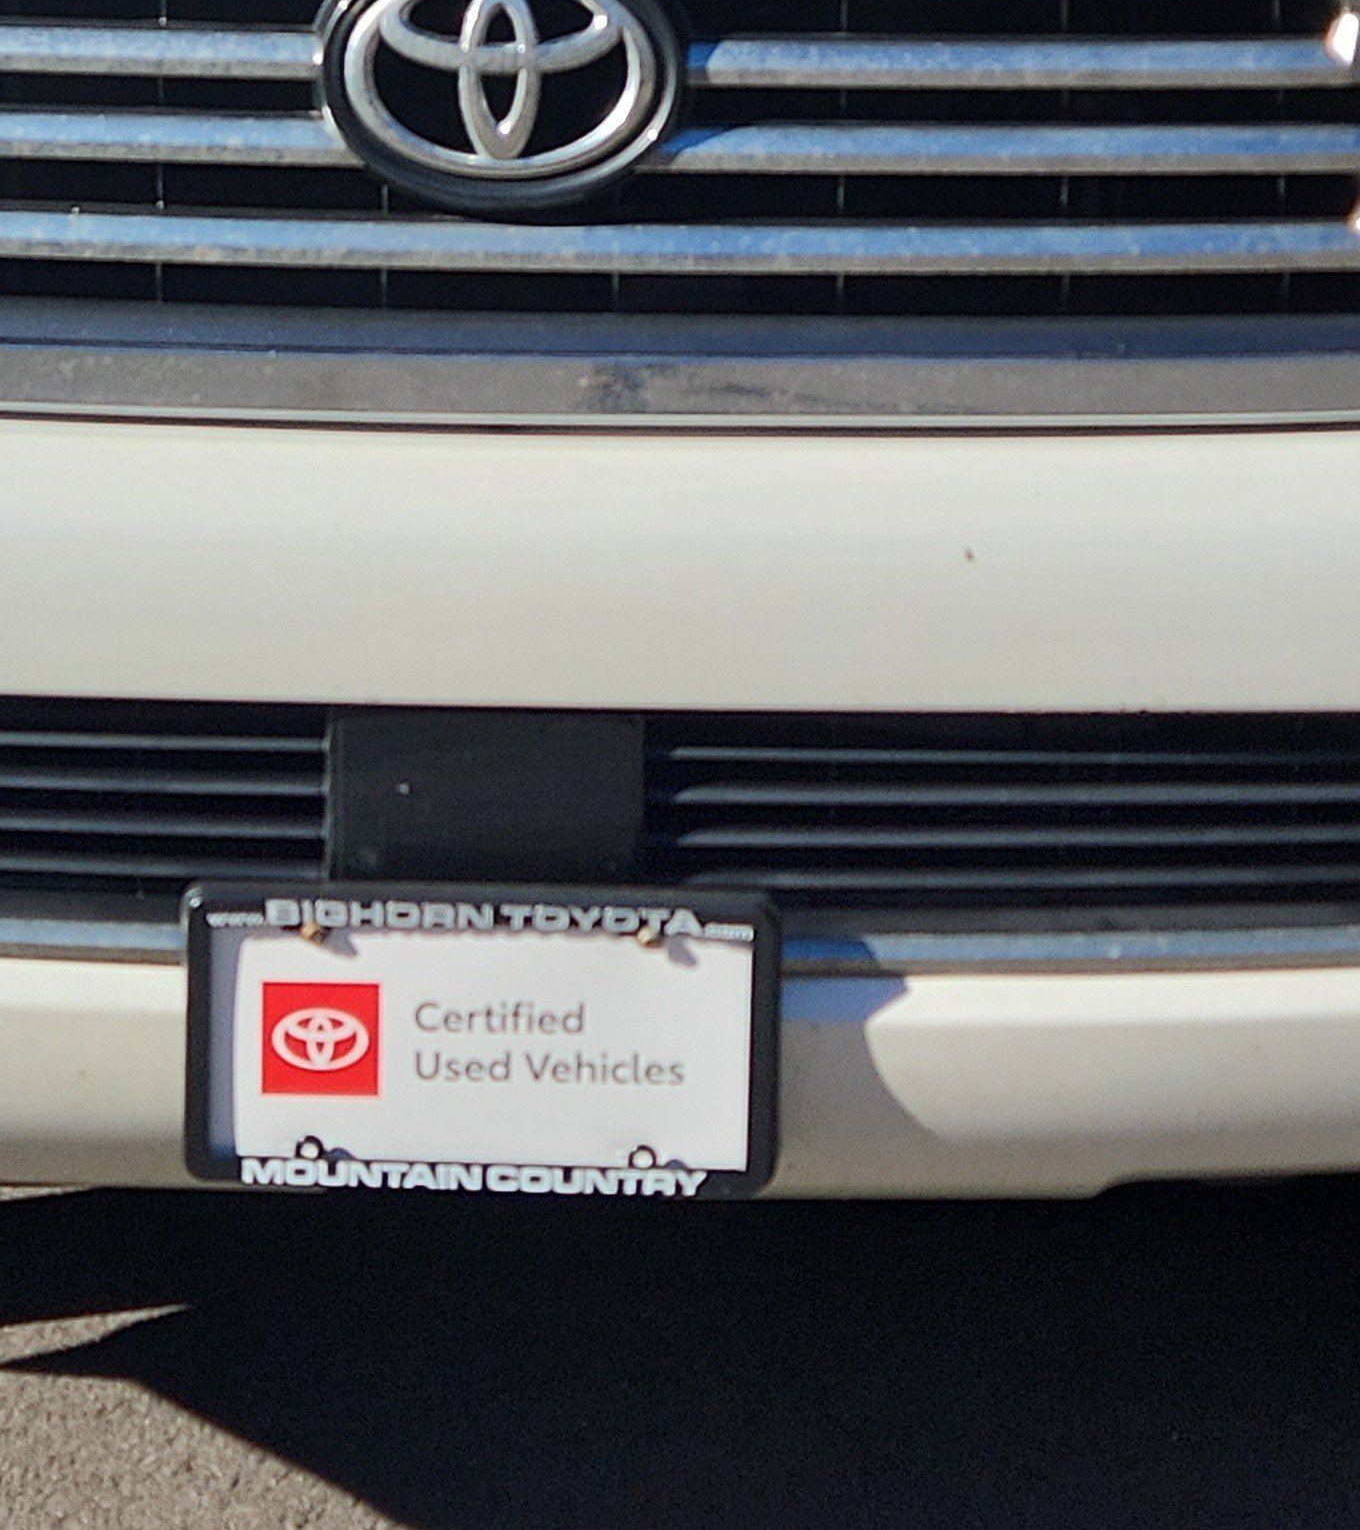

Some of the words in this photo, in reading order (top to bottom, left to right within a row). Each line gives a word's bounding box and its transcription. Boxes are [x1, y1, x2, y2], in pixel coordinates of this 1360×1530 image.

[264, 898, 494, 929] BIGHORN
[499, 903, 704, 937] TOYOTA
[414, 1000, 585, 1035] Certified
[414, 1050, 511, 1082] Used
[524, 1051, 686, 1086] Vehicles
[240, 1157, 483, 1192] MOUNTAIN
[485, 1164, 708, 1197] COUNTRY
